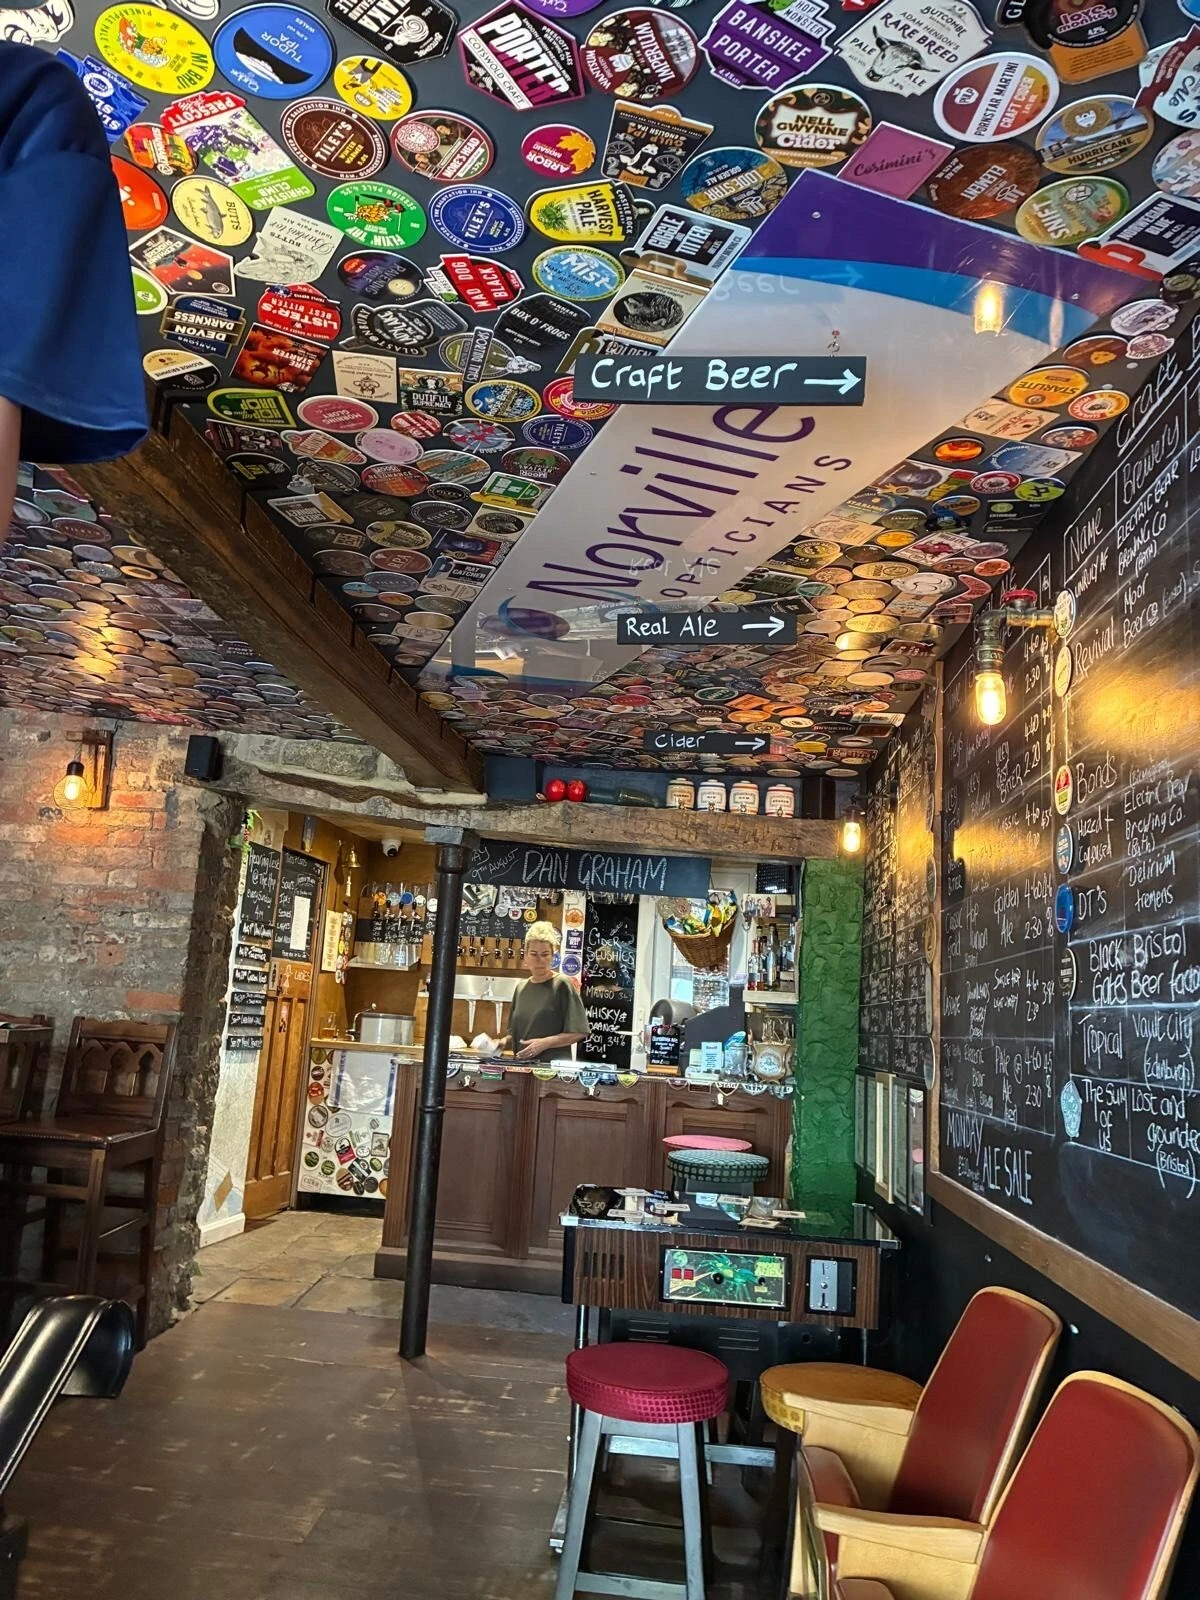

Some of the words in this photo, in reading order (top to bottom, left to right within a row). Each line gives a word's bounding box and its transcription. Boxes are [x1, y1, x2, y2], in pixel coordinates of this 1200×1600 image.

[783, 8, 823, 37] MONSTER
[921, 5, 968, 38] BUTCOMBE
[1057, 8, 1117, 33] monkey
[1061, 4, 1107, 27] love
[278, 33, 300, 51] IPA
[541, 25, 567, 52] PRESCOTT
[728, 10, 812, 63] BANSHEE
[880, 12, 915, 40] RARE
[914, 34, 960, 65] BREED
[901, 11, 927, 30] ADAM
[926, 25, 961, 51] HENSON'S
[260, 31, 303, 63] TUDOR
[478, 12, 570, 95] PORTER
[634, 21, 677, 84] IMPERIUM
[712, 34, 781, 82] PORTER
[850, 37, 877, 57] PALE
[191, 52, 209, 73] MY
[467, 36, 506, 81] COTSWOLD
[502, 78, 527, 104] CRAFT
[584, 49, 612, 91] WANTSUM
[904, 71, 928, 88] ALE
[168, 97, 236, 127] PRESCOTT
[974, 97, 1002, 137] PORNSTAR
[994, 61, 1020, 99] MARTINI
[1000, 100, 1024, 129] CRAFT
[1017, 76, 1036, 104] CIDER
[648, 127, 681, 141] ENGLISH
[776, 121, 849, 138] GWYNNE
[795, 113, 836, 128] NELL
[314, 119, 353, 163] TILEY'S
[776, 134, 842, 151] Cider
[1067, 136, 1134, 165] HURRICANE
[443, 153, 466, 178] MORE'S
[463, 136, 481, 158] HEAD
[525, 151, 571, 174] ARBOR
[704, 175, 719, 186] ALE
[719, 165, 742, 179] GOLDEN
[733, 168, 764, 190] LODE
[960, 164, 1007, 203] ELEMENT
[253, 186, 310, 209] CHRISTMAS
[257, 181, 291, 198] CLIMB
[386, 189, 417, 211] SESSION
[616, 189, 631, 215] CASTLE
[704, 179, 738, 201] STAR
[225, 201, 242, 232] BUTTS
[465, 200, 491, 240] TILEY'S
[576, 201, 598, 228] PALE
[587, 189, 614, 238] HARVEST
[623, 214, 634, 235] ROCK
[1033, 200, 1072, 241] SNIFT
[1118, 201, 1175, 241] NORWEGIAN
[1146, 216, 1175, 236] BLUE
[269, 232, 302, 247] BUTTS
[647, 215, 686, 250] GIGGLE
[676, 224, 714, 256] TITTER
[451, 262, 474, 281] DOG
[479, 268, 510, 298] BLACK
[561, 252, 611, 290] Mist
[271, 298, 305, 313] BITTER
[465, 287, 493, 307] MAD
[548, 300, 578, 318] TANNERS
[174, 311, 235, 330] DARKNESS
[261, 302, 338, 330] LISTER'S
[305, 306, 333, 319] BEST
[510, 307, 530, 323] BOX
[540, 319, 571, 341] FROGS
[174, 324, 227, 341] DEVON
[472, 330, 491, 359] SPORTING
[272, 347, 314, 365] STARTER
[289, 359, 312, 372] FIRE
[590, 356, 684, 399] Craft
[705, 358, 798, 391] Beer
[1017, 380, 1080, 397] STARLITE
[239, 397, 276, 411] DROP
[412, 392, 451, 404] DUTIFUL
[412, 400, 452, 409] SUPREMACY
[1116, 352, 1178, 448] Craft
[256, 408, 282, 420] HOP
[320, 412, 362, 426] MORNING
[552, 423, 565, 445] TILEY'S
[1122, 415, 1180, 505] Brewery
[519, 470, 548, 479] MOOR
[526, 402, 816, 601] Norville
[1116, 499, 1154, 550] ELECTRIC
[1154, 459, 1181, 507] BEAR
[660, 453, 853, 598] OPTICIANS
[1069, 508, 1104, 571] Name
[452, 569, 487, 580] CATCHER
[464, 565, 480, 574] RAT
[1074, 559, 1100, 599] UNRULY
[1097, 547, 1109, 574] AF
[1124, 572, 1151, 615] Moor
[626, 618, 671, 638] Real
[679, 616, 720, 638] Ale
[1123, 615, 1147, 650] Beer
[1074, 614, 1116, 680] Revival
[655, 732, 706, 750] Cider
[1076, 752, 1118, 804] Bonds
[1125, 811, 1167, 841] Brewing
[487, 848, 520, 875] AUGUST
[521, 850, 569, 885] DAN
[577, 852, 668, 891] GRAHAM
[1128, 849, 1178, 887] Delirium
[993, 882, 1020, 916] Golden
[588, 927, 620, 947] CIDER
[1133, 926, 1188, 968] Bristol
[586, 947, 635, 968] SLUSHIES
[1088, 937, 1123, 973] Black
[585, 985, 615, 1001] MANGO
[1130, 969, 1164, 1000] Beer
[585, 1005, 621, 1024] WHISKY
[1077, 1012, 1124, 1070] Tropical
[1082, 1078, 1105, 1123] The
[1131, 1087, 1158, 1116] Lost
[1159, 1093, 1187, 1121] and
[1099, 1110, 1114, 1136] of
[946, 1110, 985, 1168] MONDAY
[1098, 1129, 1112, 1152] us
[981, 1145, 1001, 1191] ALE
[1003, 1146, 1034, 1206] SALE
